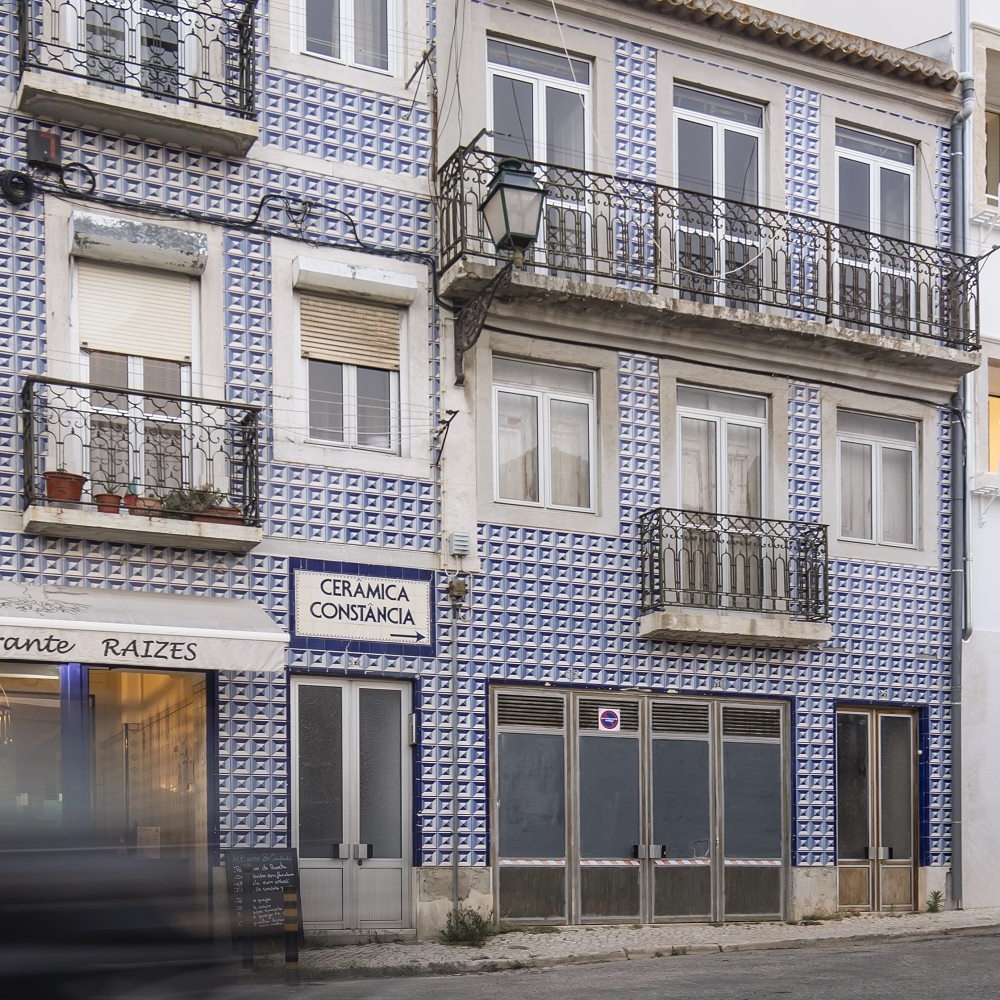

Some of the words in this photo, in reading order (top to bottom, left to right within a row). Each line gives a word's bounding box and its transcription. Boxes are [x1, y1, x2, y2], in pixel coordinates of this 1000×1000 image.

[320, 578, 410, 602] CERÂMICA
[309, 601, 416, 626] CONSTÂNCIA
[0, 634, 76, 654] ante
[101, 638, 197, 661] RAIZES
